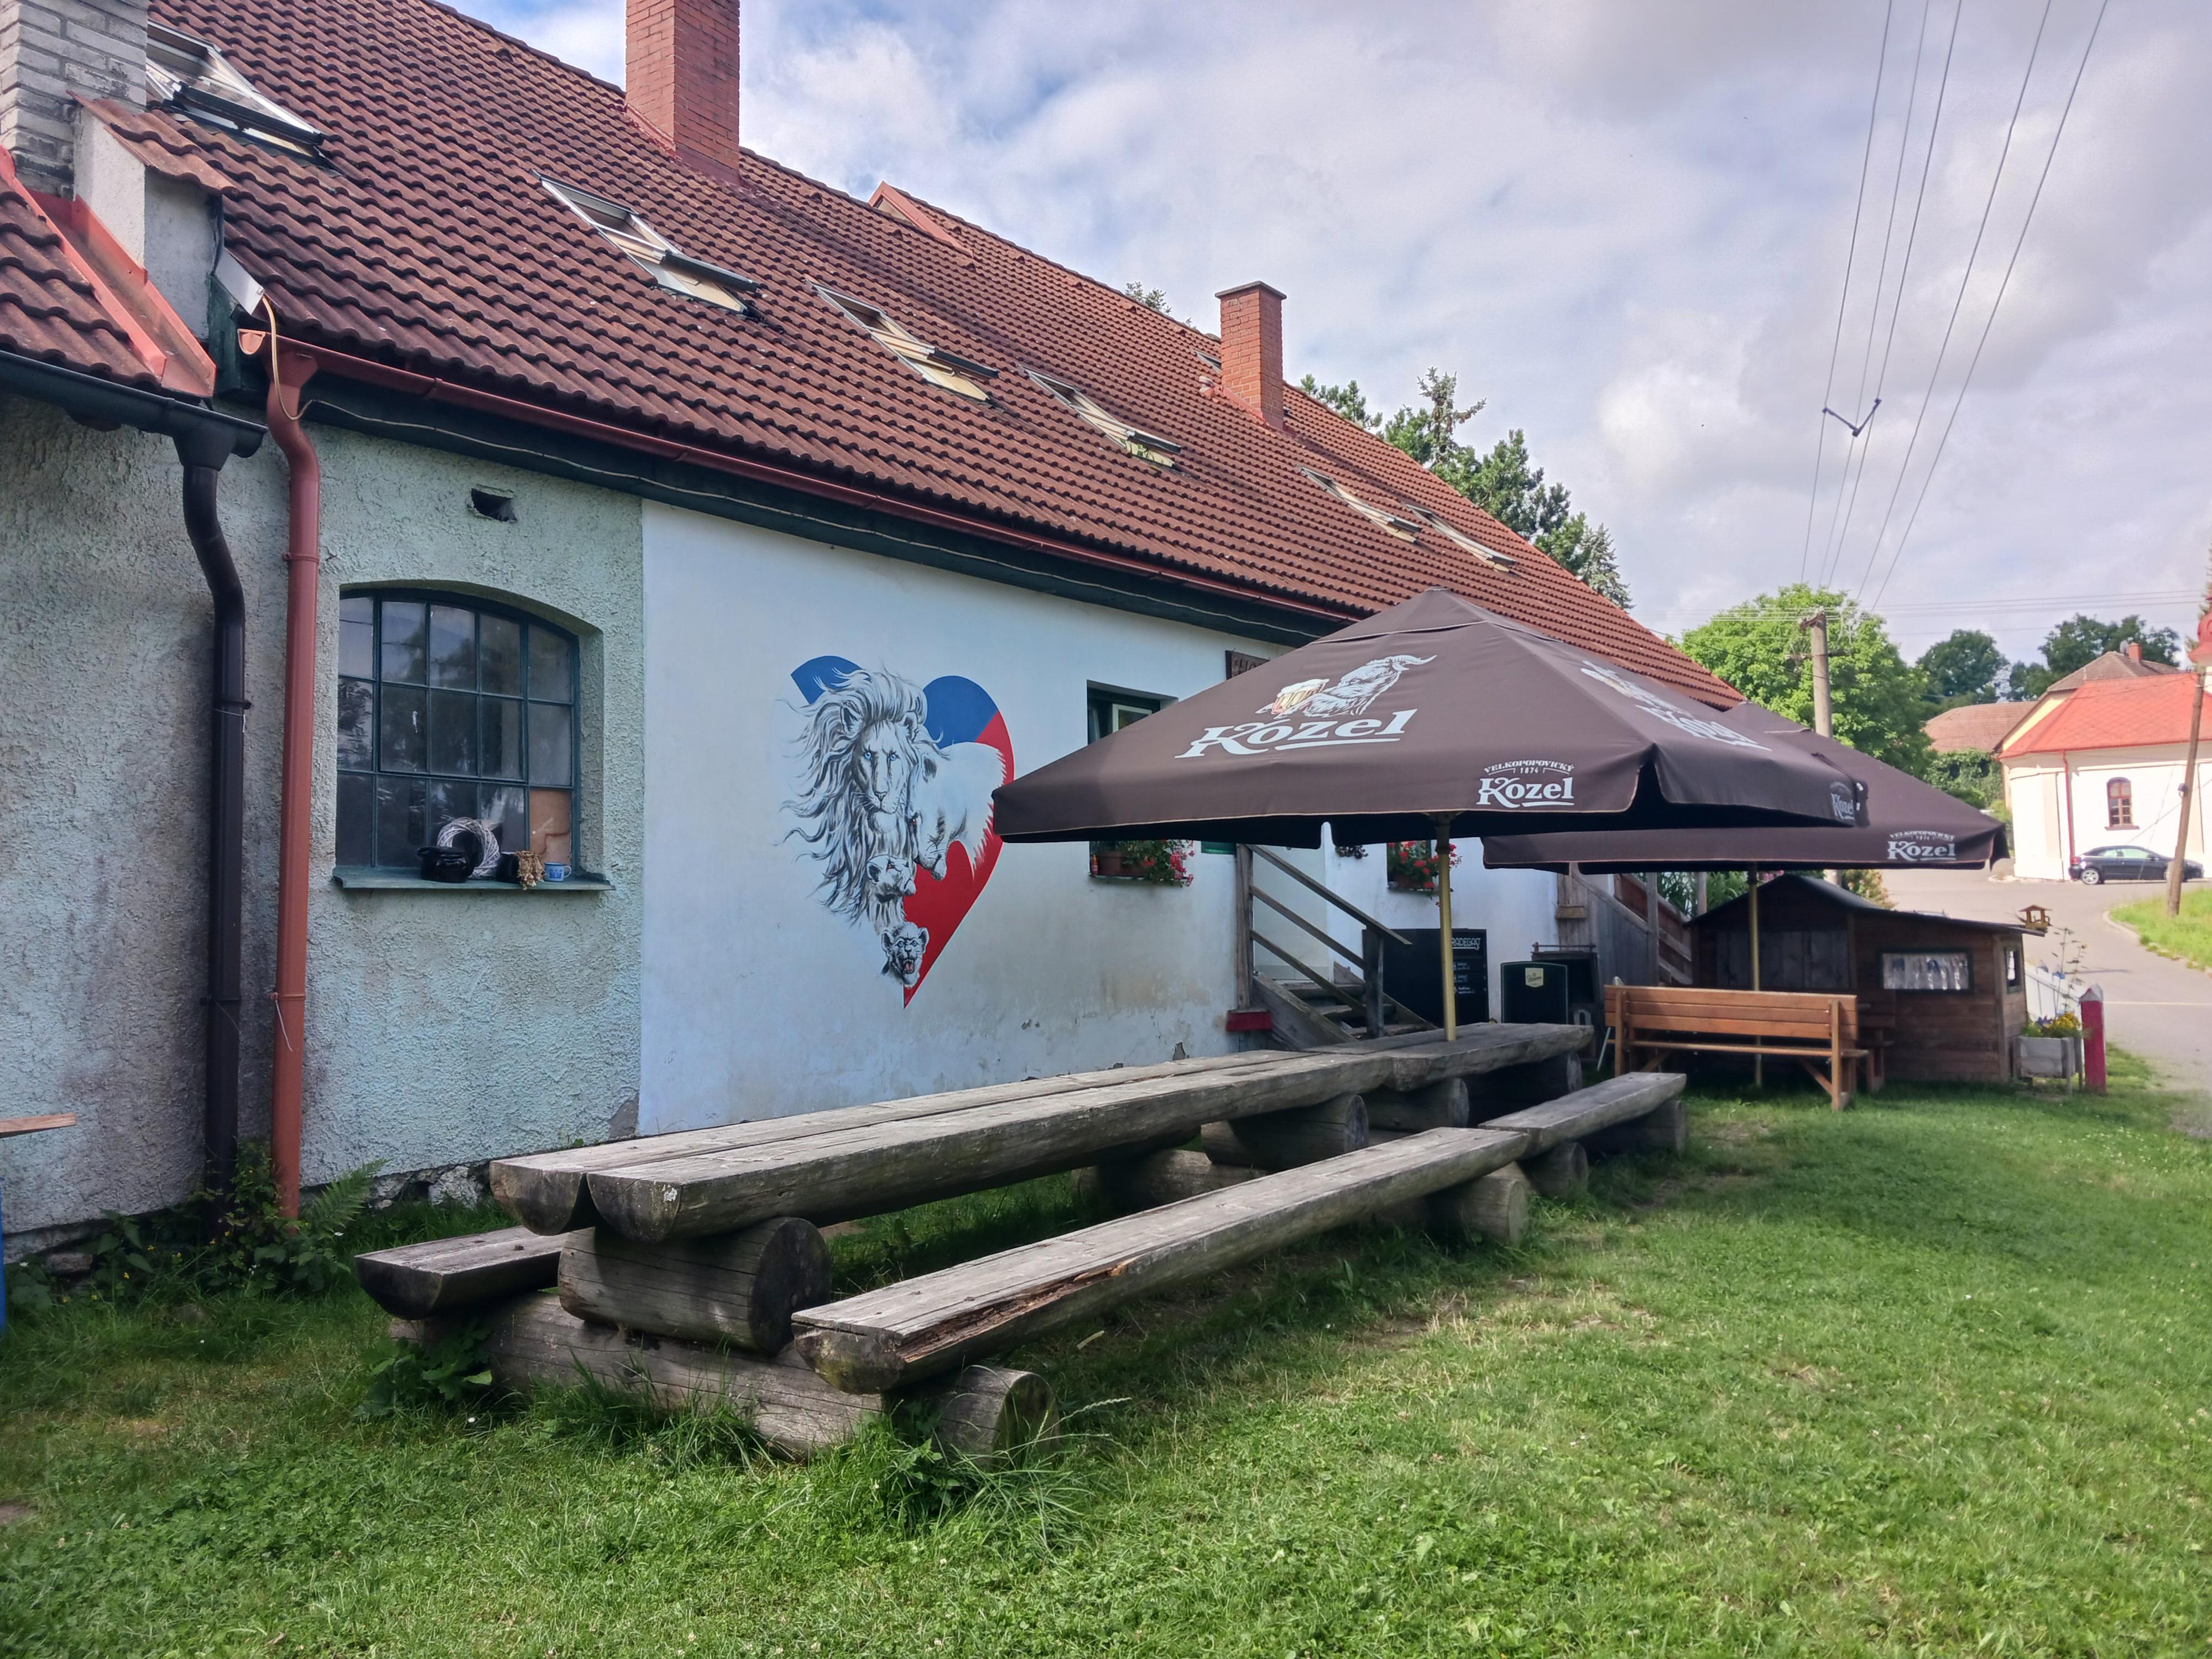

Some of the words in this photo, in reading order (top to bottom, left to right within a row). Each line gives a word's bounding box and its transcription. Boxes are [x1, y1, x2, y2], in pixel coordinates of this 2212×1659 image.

[1174, 708, 1417, 758] Kozel
[1484, 760, 1574, 773] VELKOPOPOVICKÝ
[1476, 777, 1575, 808] Kozel
[1887, 841, 1957, 861] Kozel
